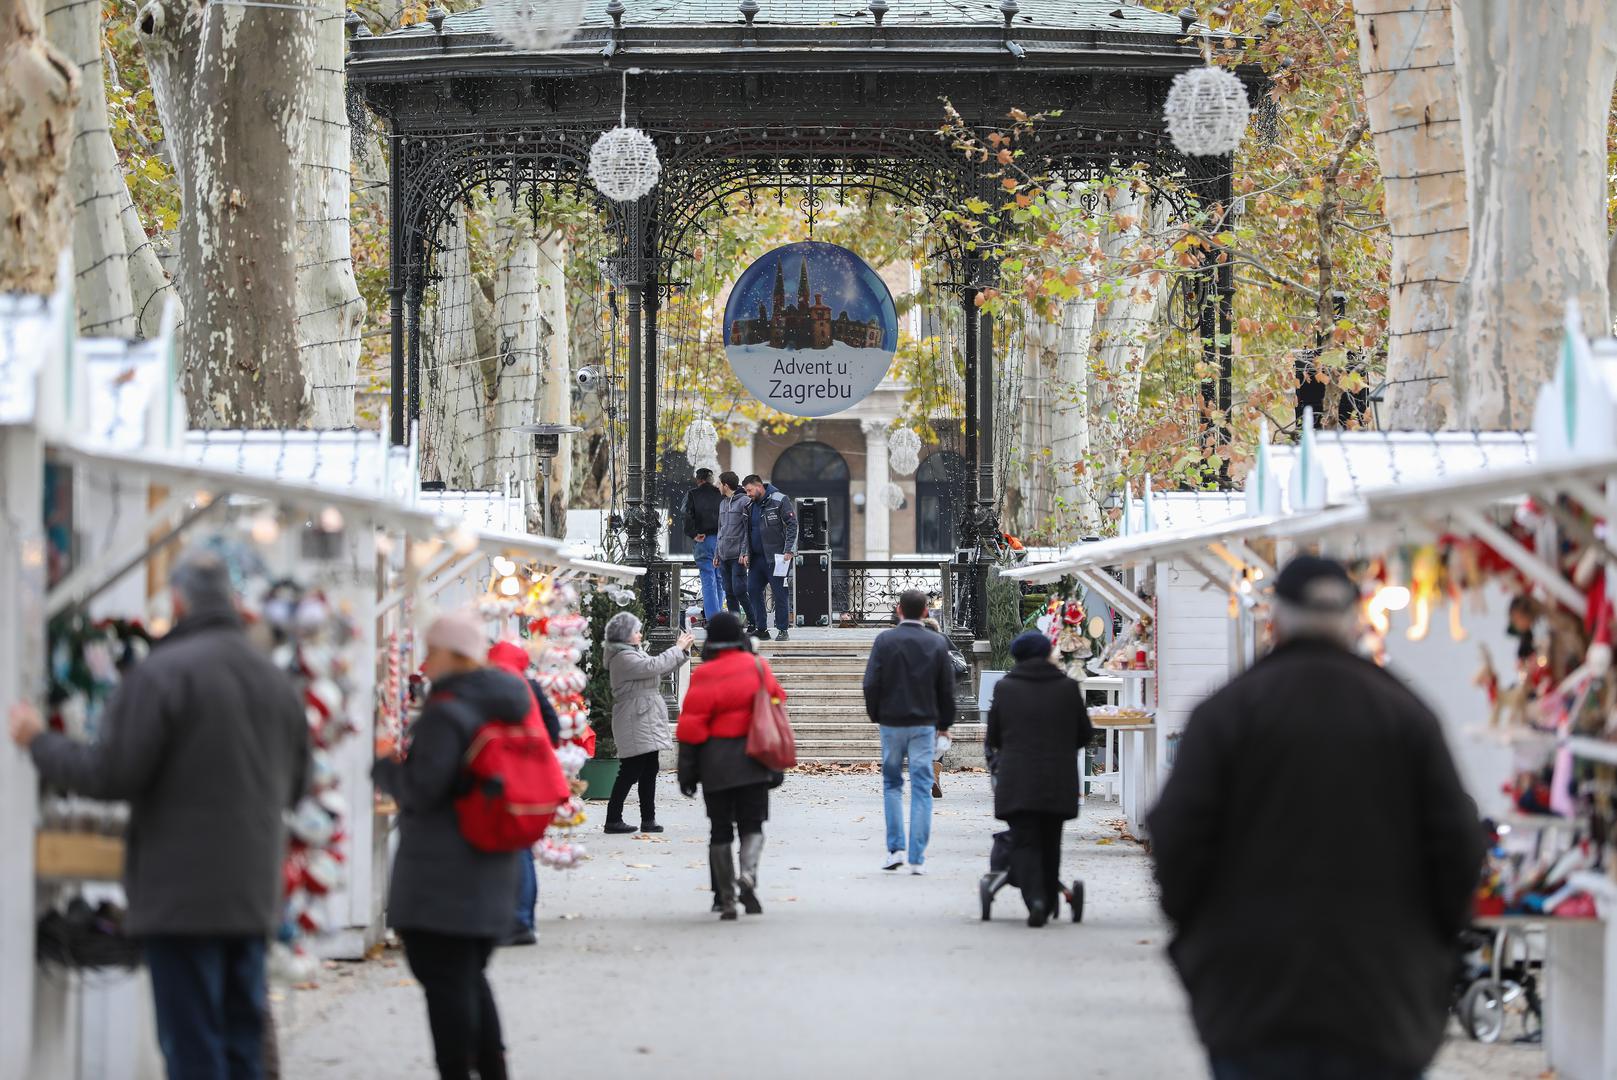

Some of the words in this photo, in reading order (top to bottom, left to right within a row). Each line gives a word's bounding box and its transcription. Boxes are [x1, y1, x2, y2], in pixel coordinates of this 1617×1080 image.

[773, 357, 833, 375] Advent
[837, 363, 847, 375] u
[768, 379, 852, 404] Zagrebu
